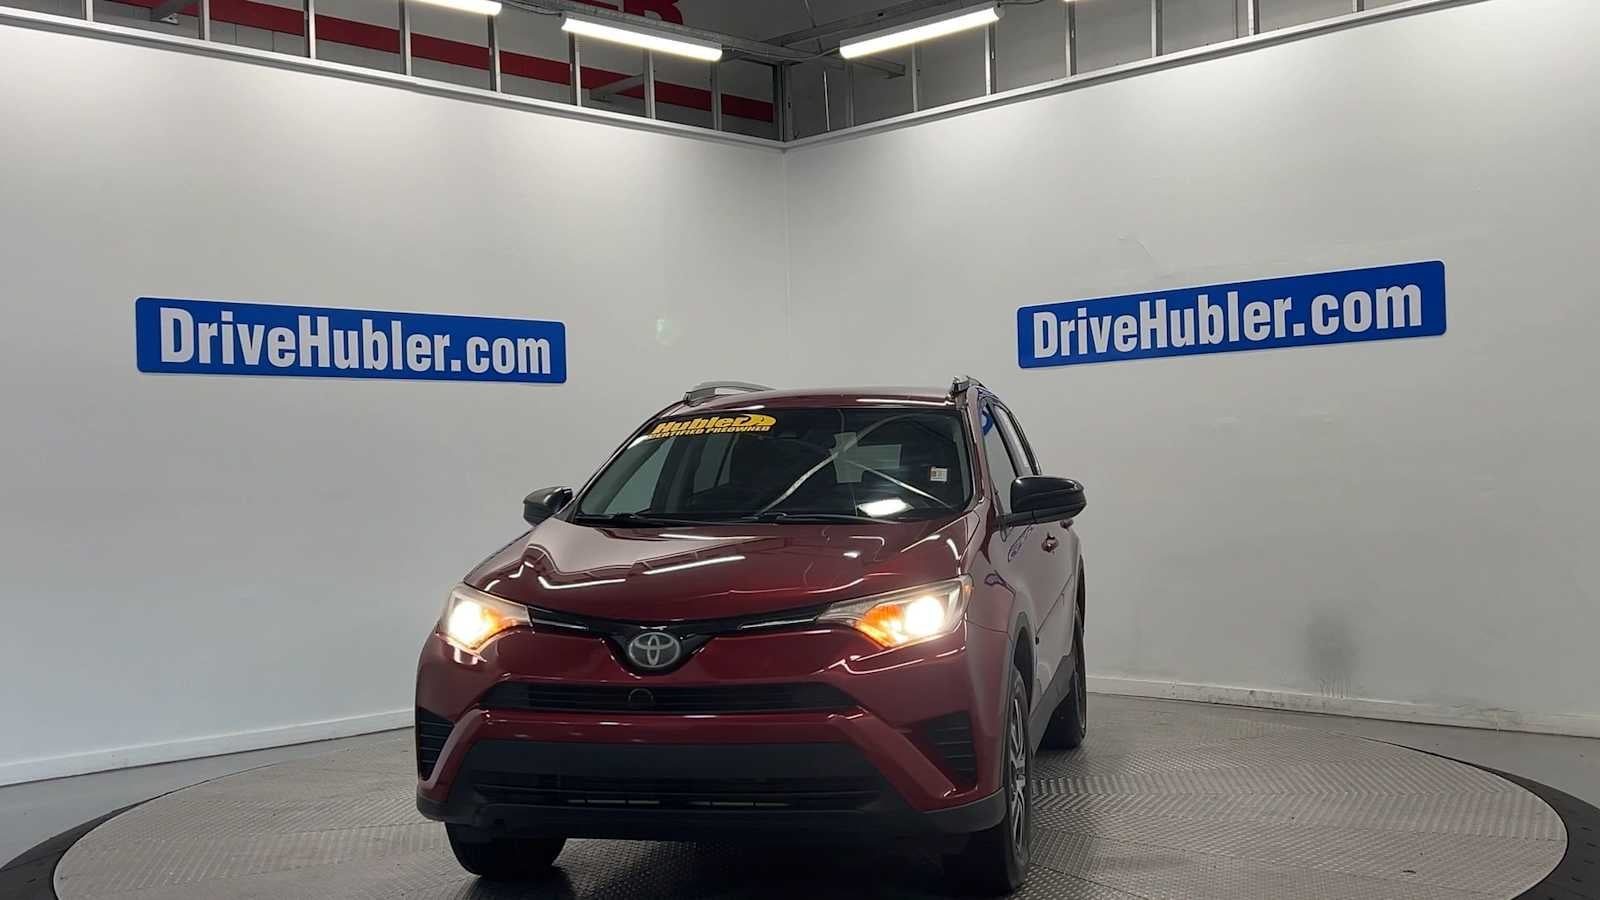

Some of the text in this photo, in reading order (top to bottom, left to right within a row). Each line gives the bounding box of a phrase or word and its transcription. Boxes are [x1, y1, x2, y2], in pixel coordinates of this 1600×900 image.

[159, 306, 551, 375] DriveHubler.com
[1033, 282, 1422, 359] DriveHubler.com
[653, 416, 752, 434] Hubler
